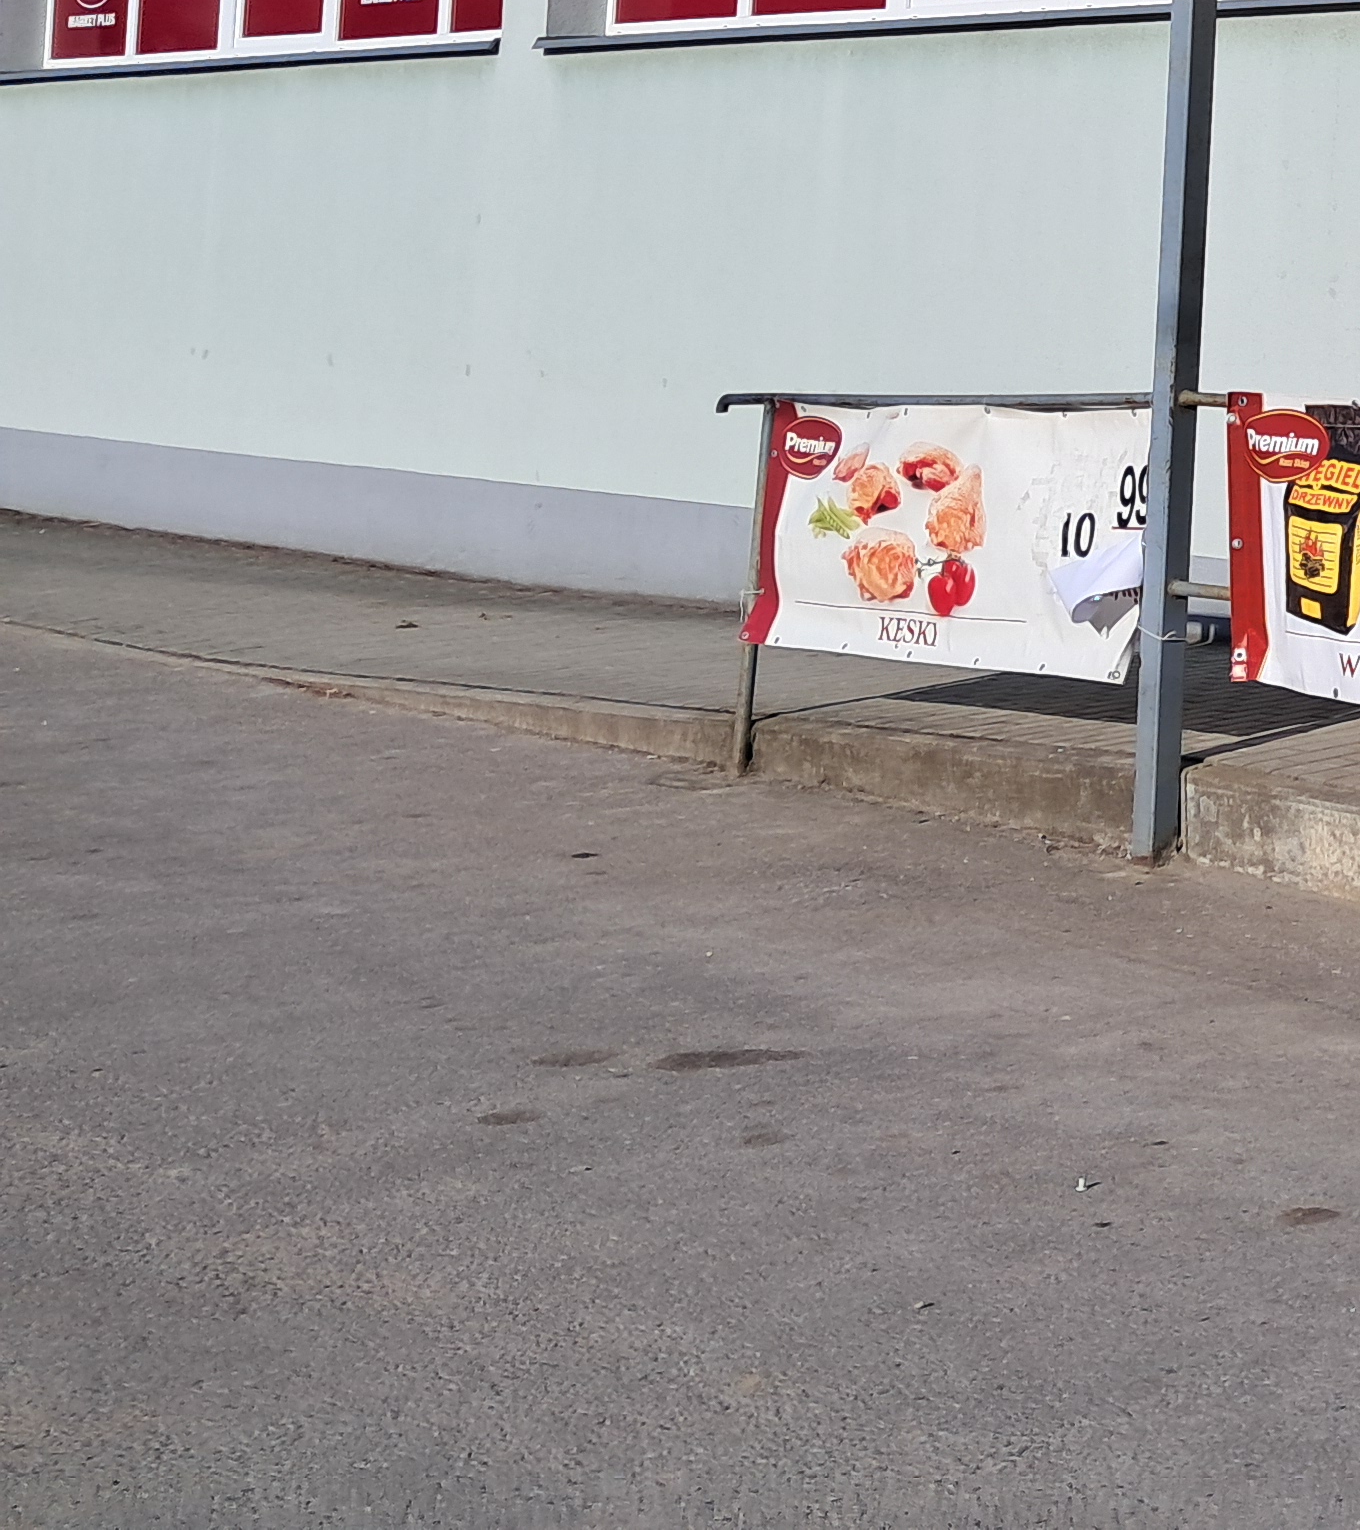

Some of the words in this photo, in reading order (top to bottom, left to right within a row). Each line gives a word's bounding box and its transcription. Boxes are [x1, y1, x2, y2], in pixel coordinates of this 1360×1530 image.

[1246, 428, 1320, 456] Premium
[1291, 489, 1355, 511] DRZEWNY
[1061, 512, 1096, 558] 10
